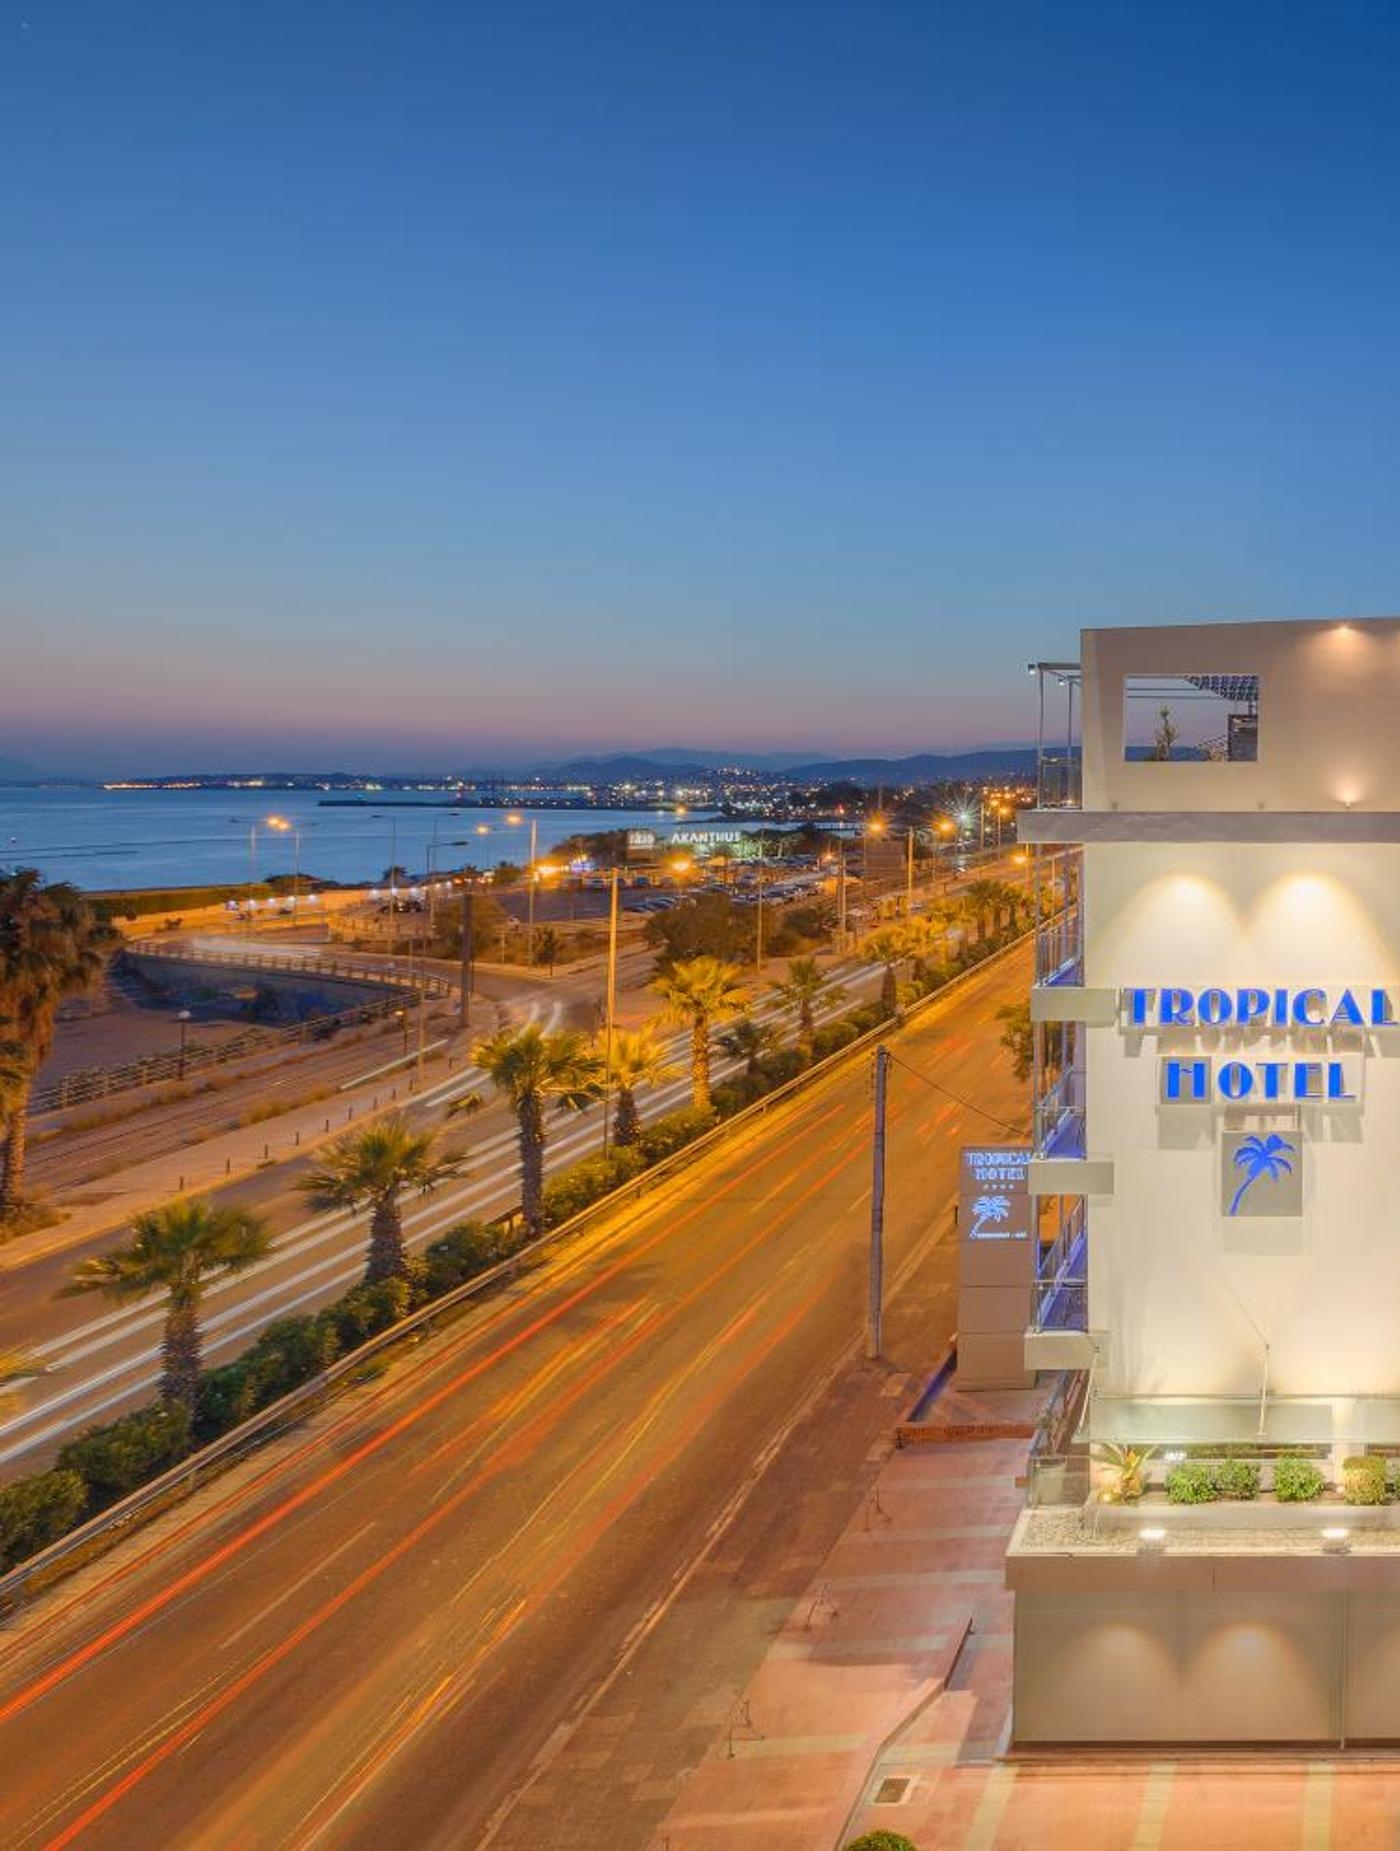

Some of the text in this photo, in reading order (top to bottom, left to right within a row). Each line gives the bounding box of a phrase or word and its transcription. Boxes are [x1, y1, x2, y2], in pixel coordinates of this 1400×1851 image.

[671, 832, 741, 844] AKANTHUS
[1123, 988, 1399, 1026] TROPICAL
[1164, 1061, 1356, 1099] HOTEL
